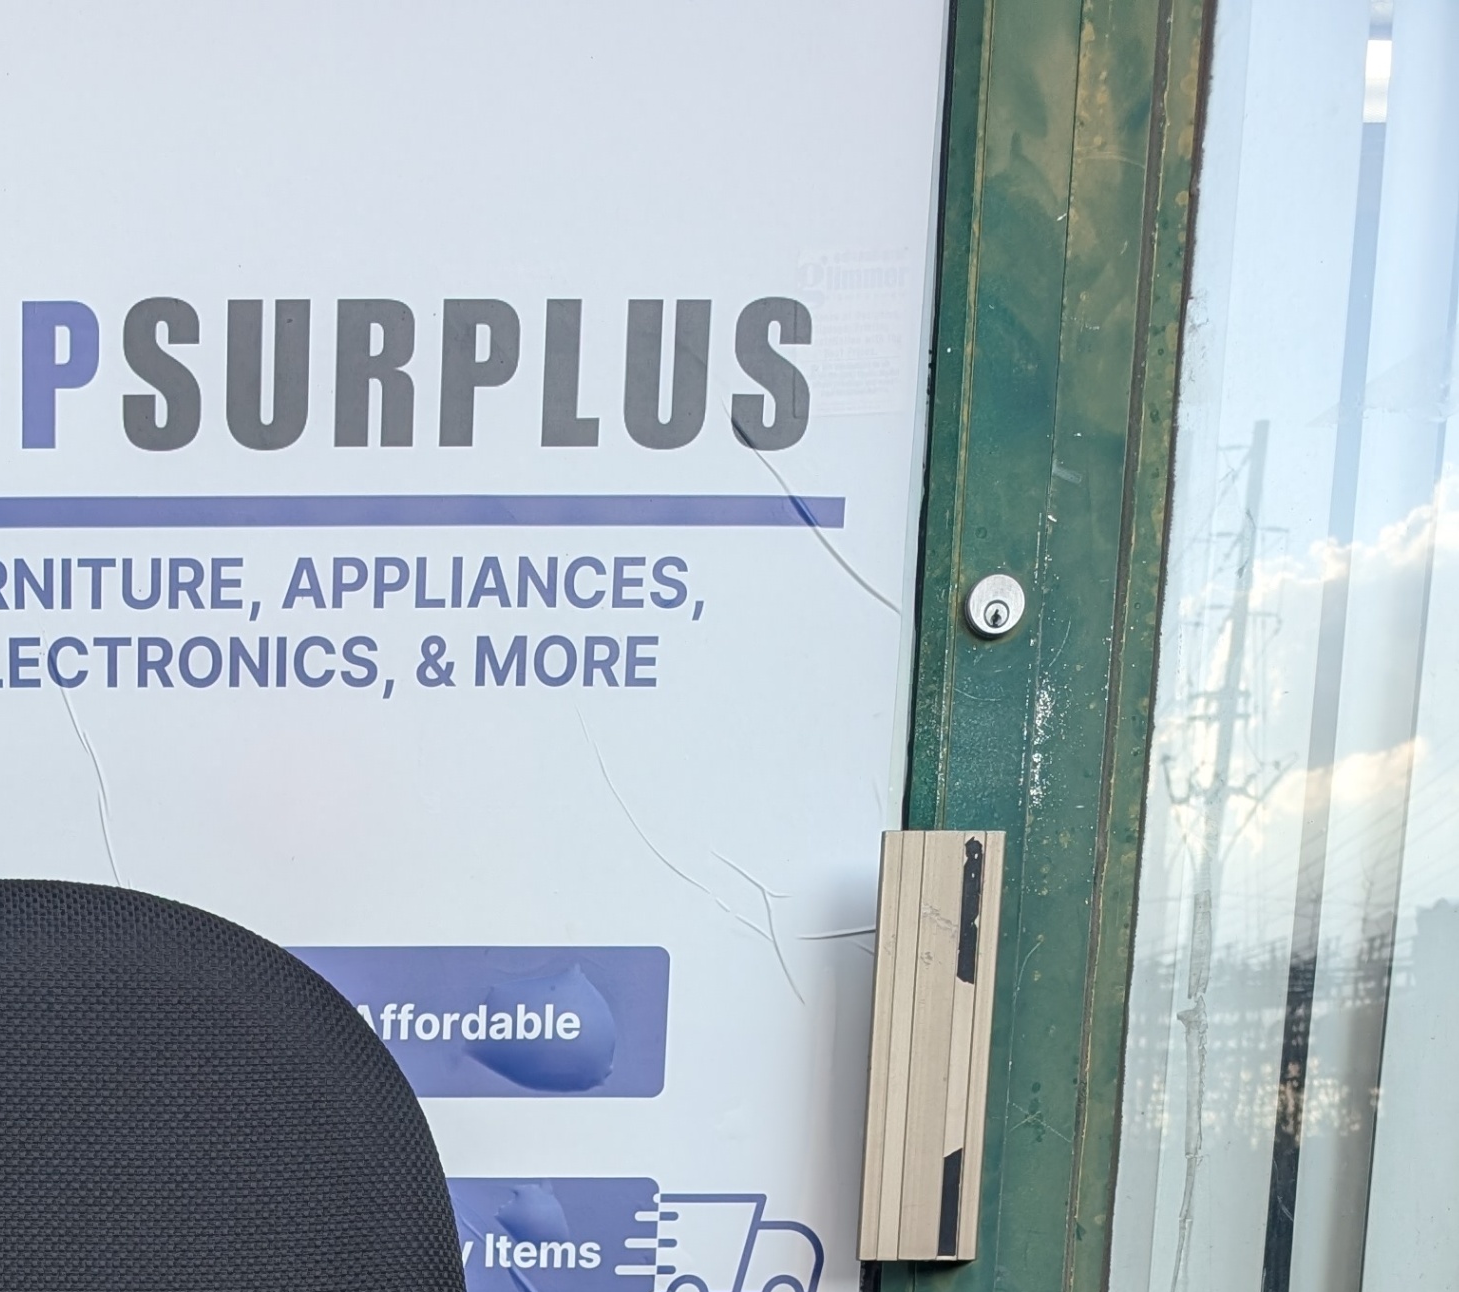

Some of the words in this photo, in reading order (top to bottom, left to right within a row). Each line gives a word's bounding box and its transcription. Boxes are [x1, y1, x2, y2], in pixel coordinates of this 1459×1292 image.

[281, 555, 705, 621] APPLIANCES,
[415, 634, 457, 688] &
[474, 634, 660, 688] MORE
[485, 1233, 601, 1269] Items
